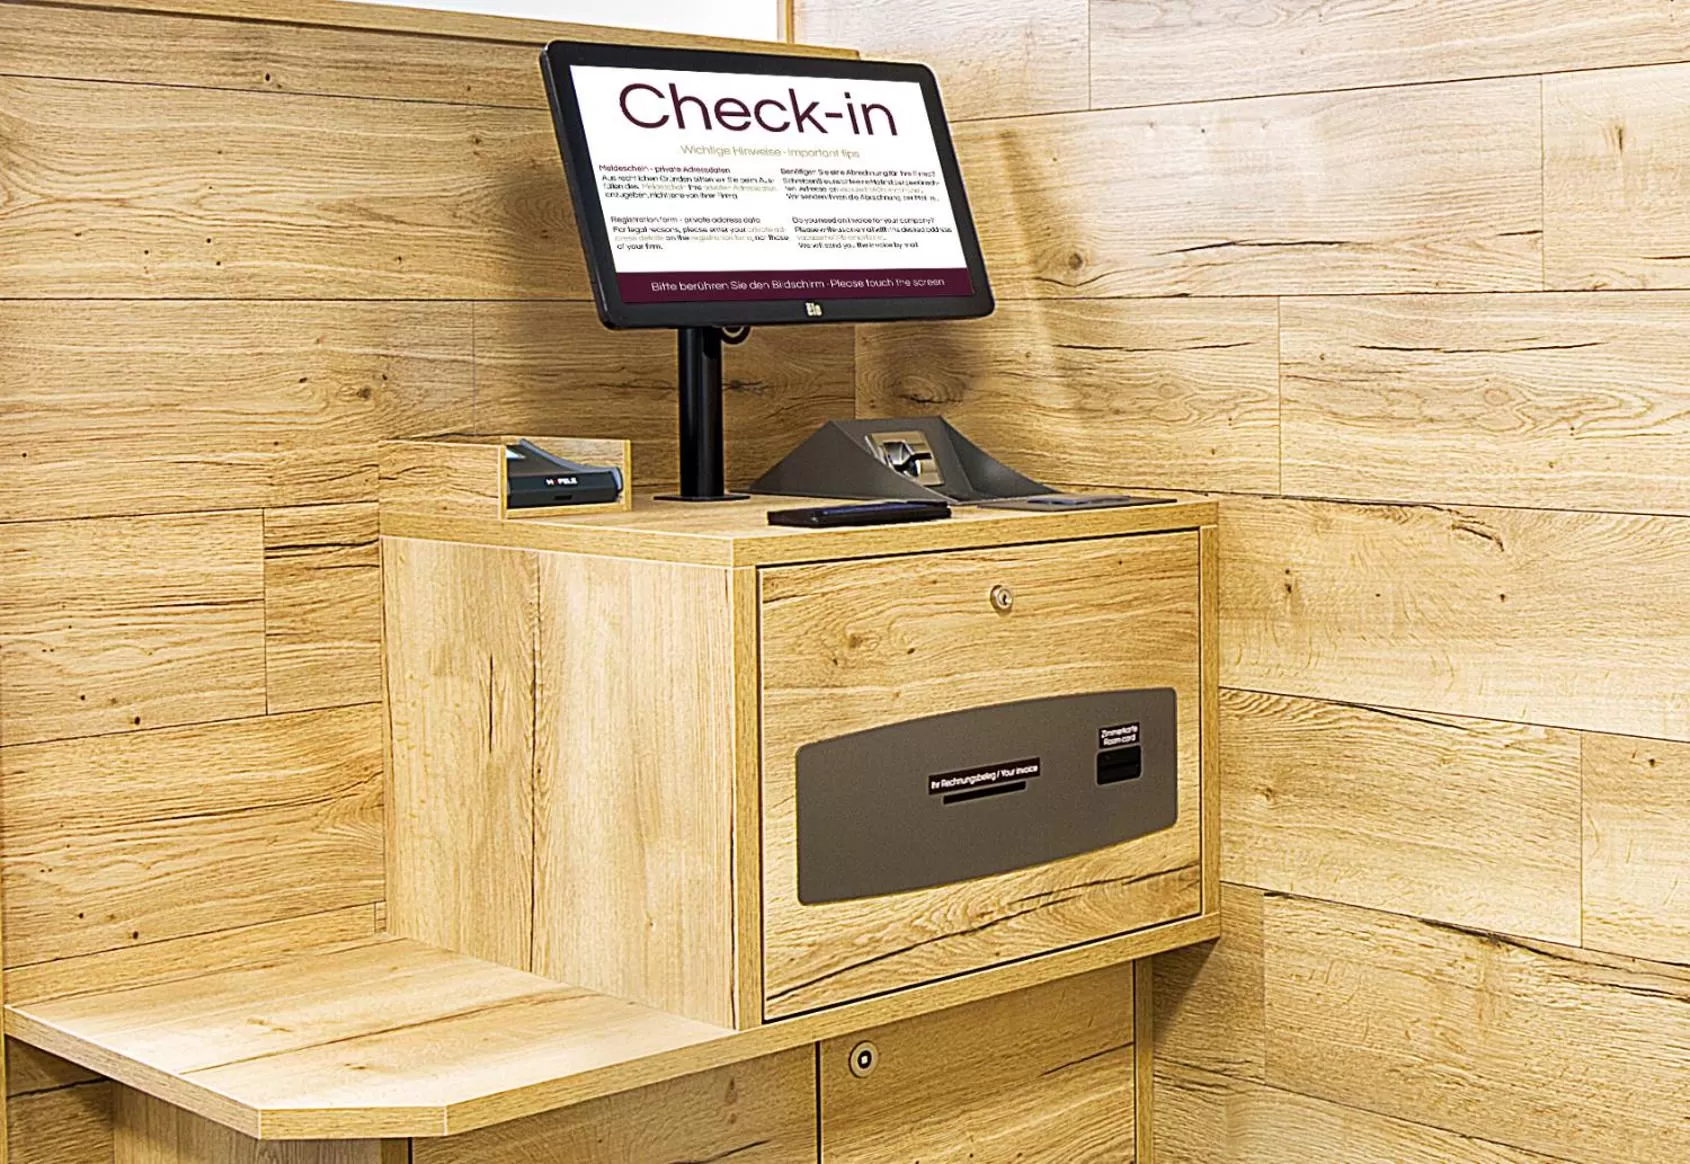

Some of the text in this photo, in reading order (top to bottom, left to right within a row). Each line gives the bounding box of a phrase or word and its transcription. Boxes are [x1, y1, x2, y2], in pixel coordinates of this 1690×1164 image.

[619, 83, 898, 136] Check-in
[680, 145, 731, 157] Wichtige
[732, 146, 781, 156] Hinweise
[842, 149, 860, 160] tips
[655, 165, 682, 173] private
[627, 226, 648, 234] legal
[651, 282, 678, 291] Bitte
[679, 281, 730, 290] berühren
[730, 281, 748, 290] Sie
[749, 280, 770, 290] den
[771, 279, 825, 289] Bildschirm
[830, 279, 864, 288] Please
[865, 279, 894, 287] touch
[1101, 725, 1138, 739] Zimmerkarte
[1103, 733, 1136, 746] Room card
[931, 781, 940, 790] Ihr
[941, 772, 997, 785] Rechnungsbeleg
[1001, 768, 1016, 777] Your
